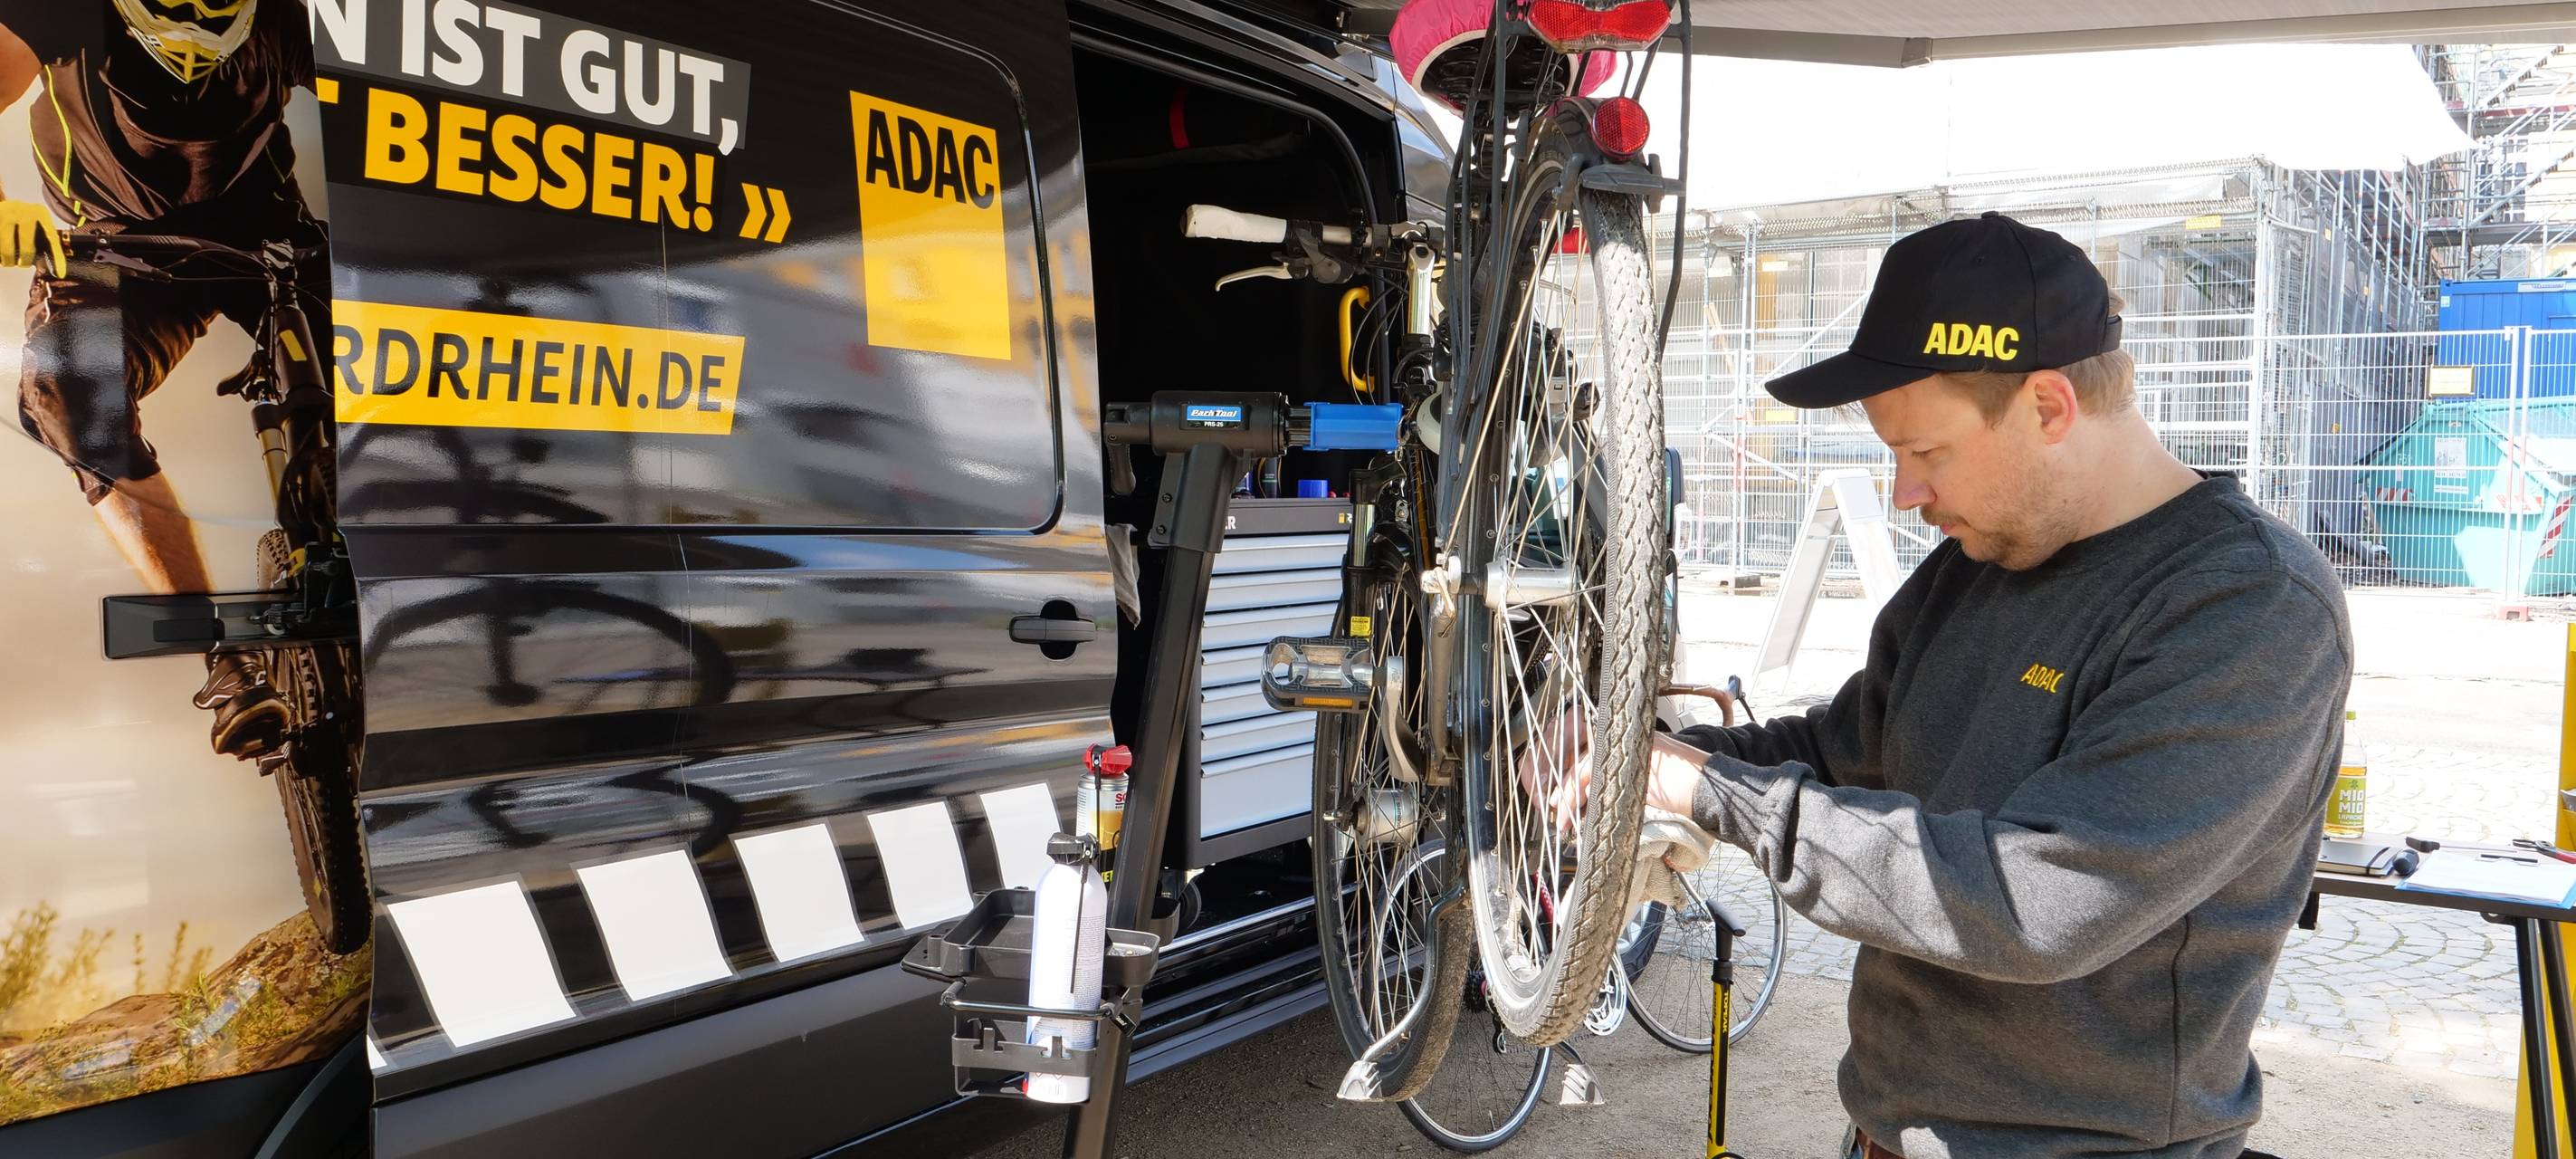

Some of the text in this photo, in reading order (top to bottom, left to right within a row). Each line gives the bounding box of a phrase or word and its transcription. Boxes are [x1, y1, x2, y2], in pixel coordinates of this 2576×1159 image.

[401, 0, 541, 97] IST
[560, 30, 739, 156] GUT,
[364, 87, 715, 233] BESSER!
[866, 108, 995, 209] ADAC
[333, 324, 725, 412] RDRHEIN.DE
[1922, 322, 2019, 360] ADAC
[1225, 515, 1236, 530] R
[2020, 664, 2064, 693] ADAC
[2339, 801, 2363, 813] MIO
